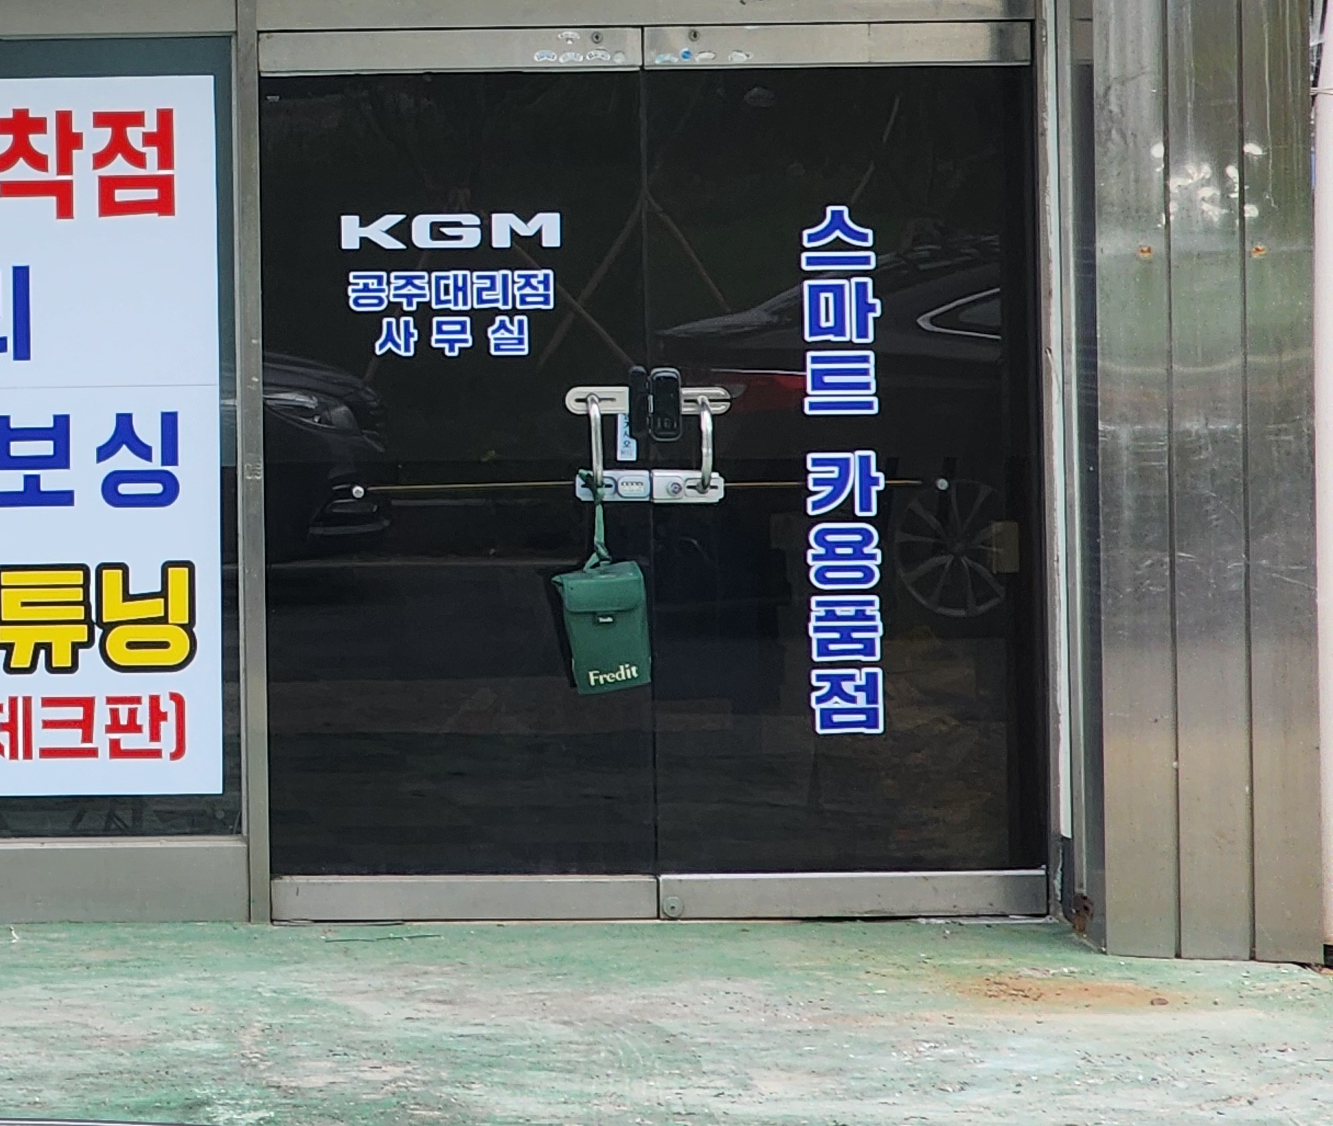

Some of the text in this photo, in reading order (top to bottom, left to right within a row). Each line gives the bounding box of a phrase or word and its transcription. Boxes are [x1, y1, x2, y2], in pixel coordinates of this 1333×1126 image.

[340, 211, 562, 251] KGM
[347, 269, 555, 313] 공주대리점
[800, 205, 886, 736] 스마트 카용품점
[587, 663, 640, 687] Fredit
